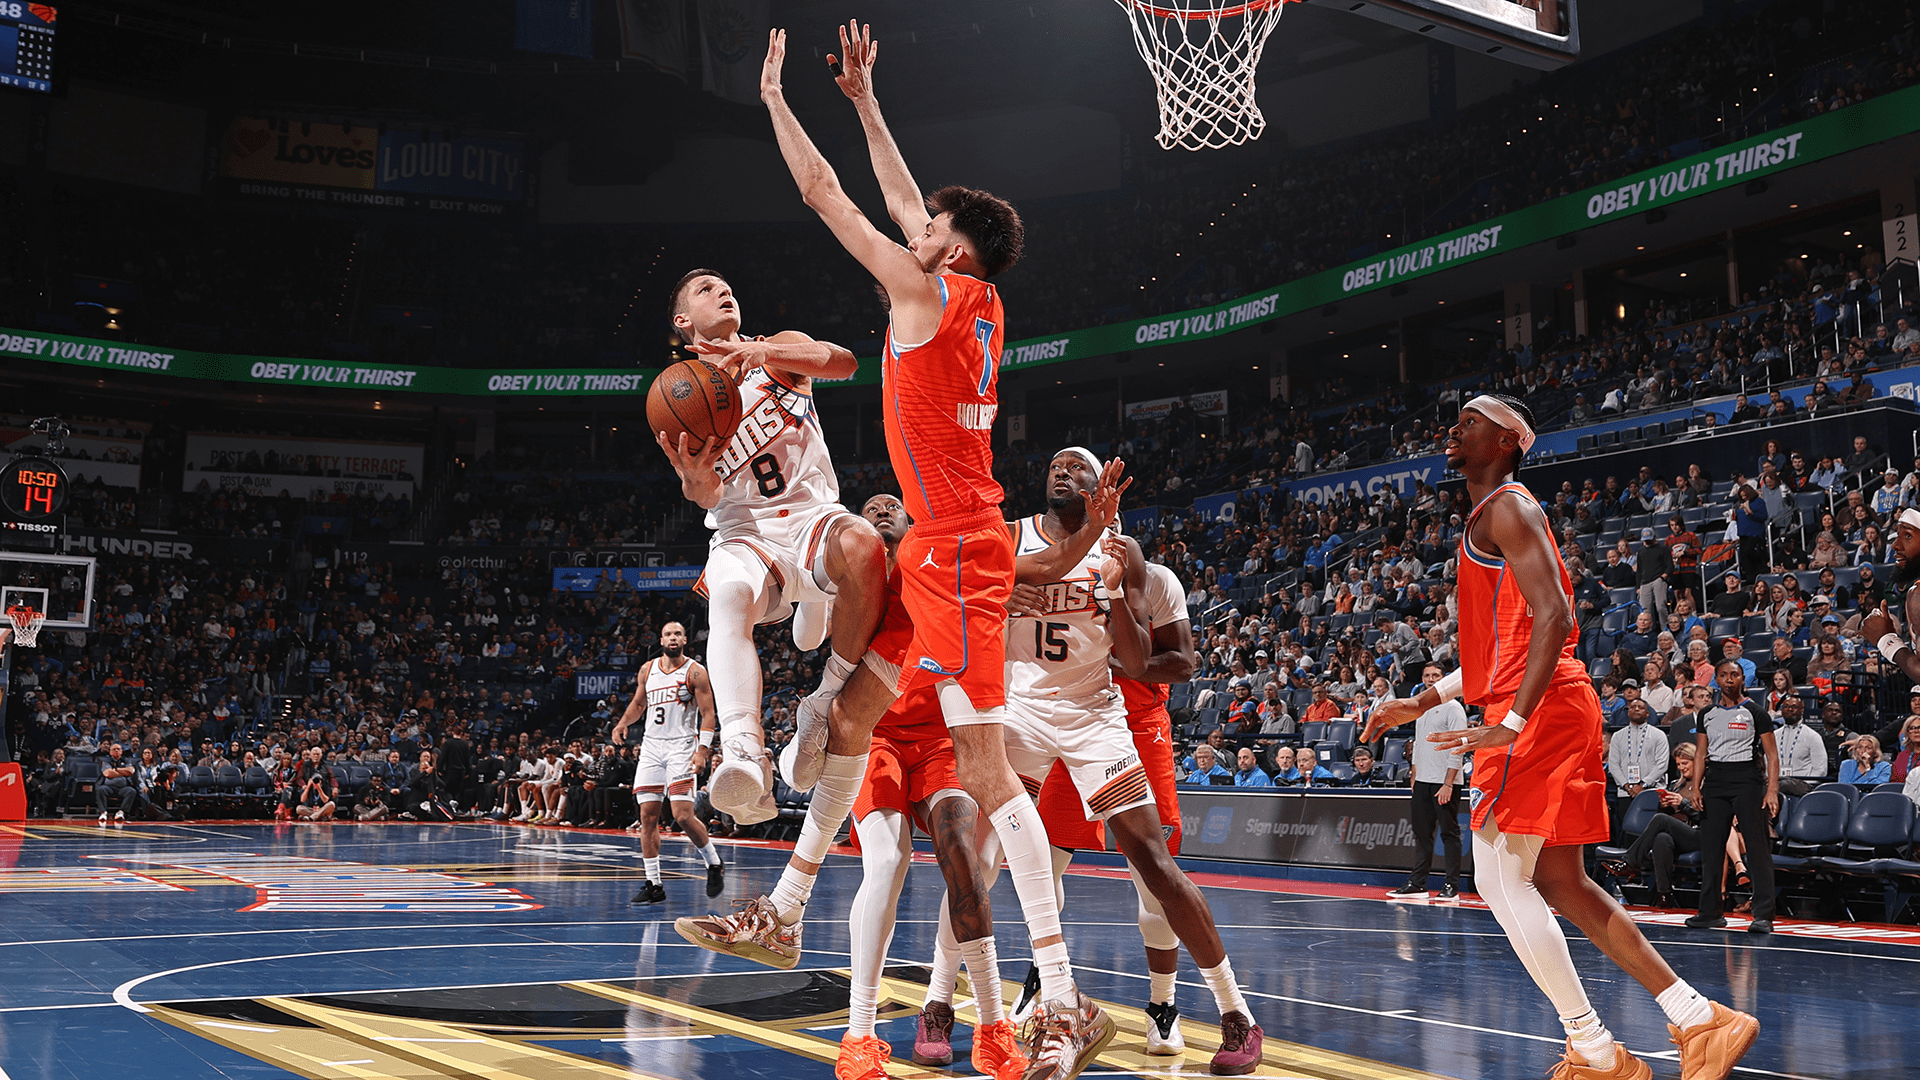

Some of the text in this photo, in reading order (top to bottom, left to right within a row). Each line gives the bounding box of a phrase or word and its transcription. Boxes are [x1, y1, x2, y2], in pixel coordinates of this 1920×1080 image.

[383, 142, 520, 191] LOUD CITY
[1587, 132, 1803, 219] OBEY YOUR THIRST
[240, 184, 503, 214] BRING THE THUNDER EXIT NOW
[1342, 225, 1503, 292] OBEY YOUR THIRST
[1135, 294, 1279, 343] OBEY YOUR THIRST
[0, 334, 174, 370] OBEY YOUR THIRST
[975, 316, 996, 396] 7
[1015, 339, 1069, 365] THIRST
[251, 362, 416, 387] OBEY YOUR THIRST
[488, 374, 643, 391] OBEY YOUR THIRST
[344, 457, 406, 474] TERRACE
[751, 453, 788, 498] 8
[18, 470, 58, 488] 10:50
[220, 475, 272, 488] POST OAK
[333, 481, 384, 493] POST OAK
[1366, 467, 1431, 497] CITY
[24, 485, 54, 513] 14
[17, 522, 58, 534] TISSOT
[43, 534, 193, 560] THUNDER
[344, 551, 368, 566] 112
[438, 556, 507, 569] @okcthu
[657, 570, 700, 579] COMMERCIAL
[638, 579, 671, 588] CLEANING
[1035, 620, 1070, 662] 15
[578, 676, 620, 695] HOME!
[654, 707, 665, 725] 3
[1245, 818, 1271, 837] Sign
[1272, 823, 1288, 838] up
[1288, 823, 1318, 836] now
[1345, 816, 1415, 850] League Pa
